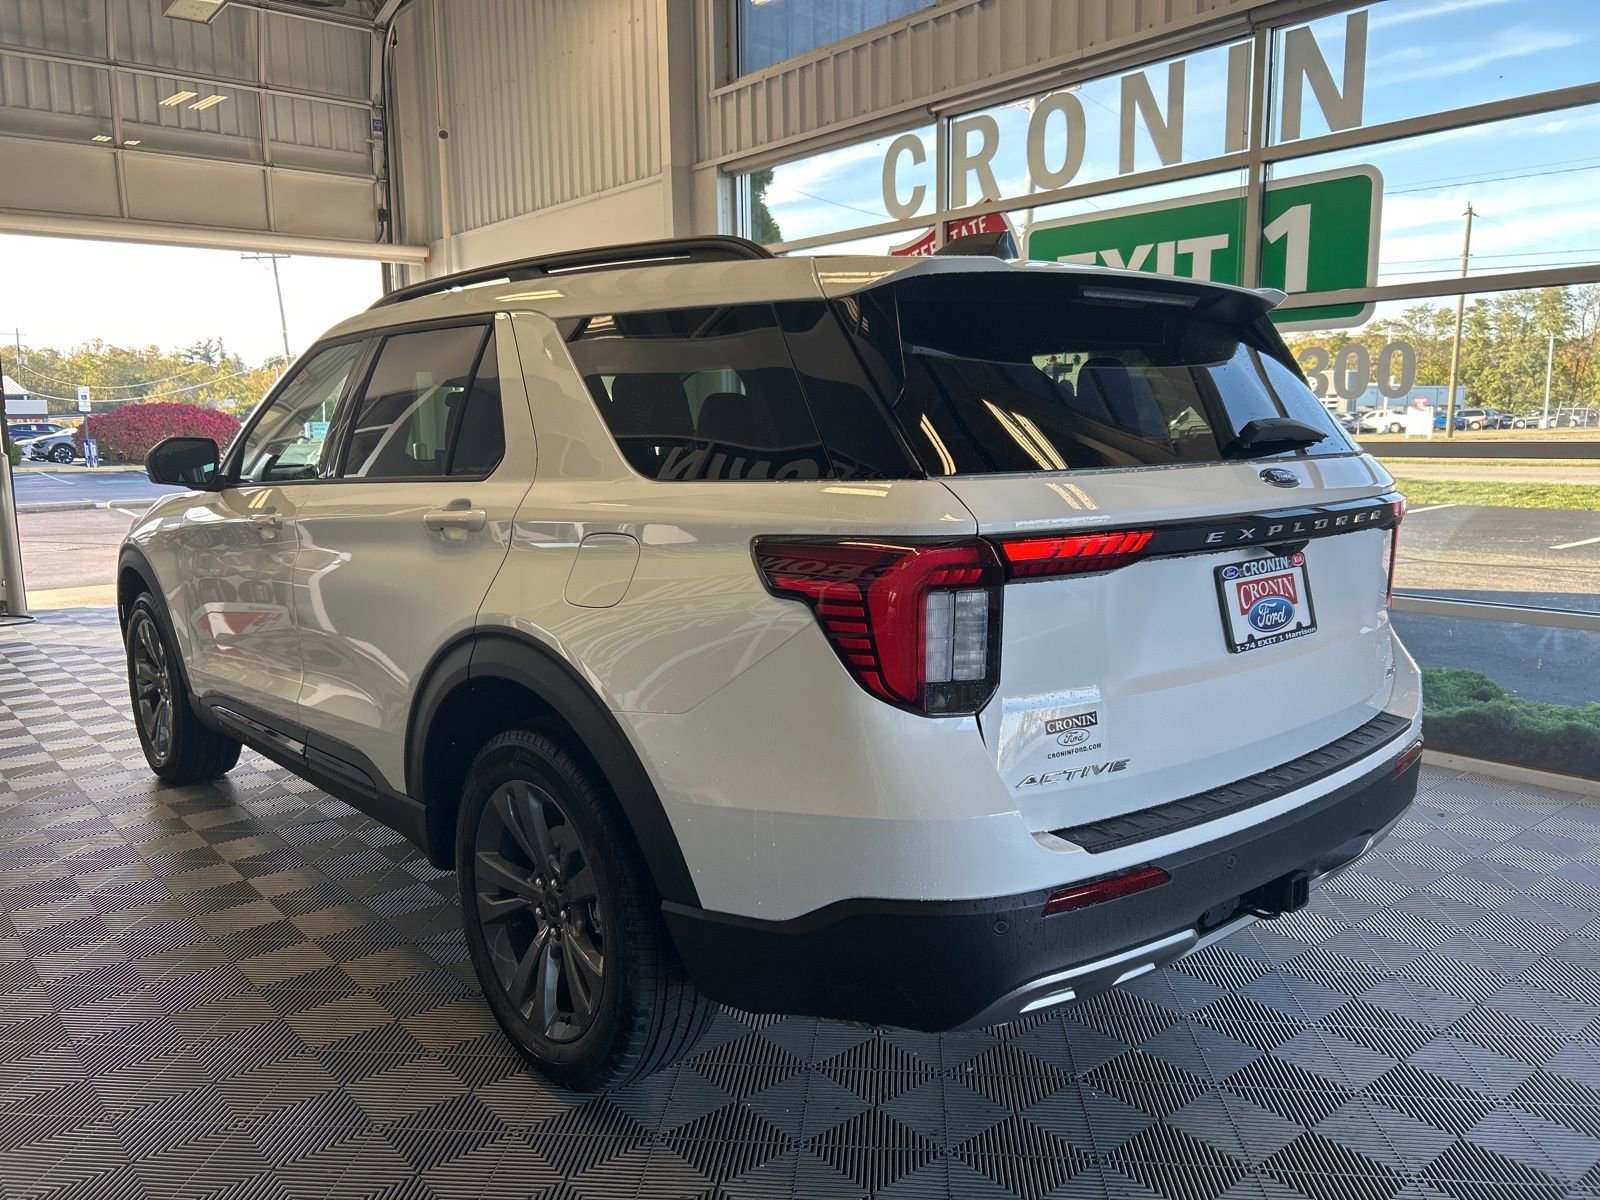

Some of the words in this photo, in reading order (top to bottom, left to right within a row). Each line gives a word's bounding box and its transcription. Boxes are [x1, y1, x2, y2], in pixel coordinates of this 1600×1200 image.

[882, 9, 1369, 219] CRONIN
[1057, 233, 1229, 281] IT
[1263, 204, 1312, 292] 1
[1298, 341, 1417, 400] 300
[1205, 509, 1382, 543] EXPLORER
[1243, 556, 1289, 577] CRONIN
[1240, 576, 1295, 610] CRONIN
[1257, 602, 1287, 627] Ford
[1258, 637, 1277, 647] EXIT
[1285, 627, 1317, 640] Harrison
[1047, 713, 1097, 733] CRONIN
[1063, 731, 1084, 744] Ford
[1047, 743, 1102, 760] CRONINFORD.COM
[1015, 759, 1131, 789] ACTIVE
